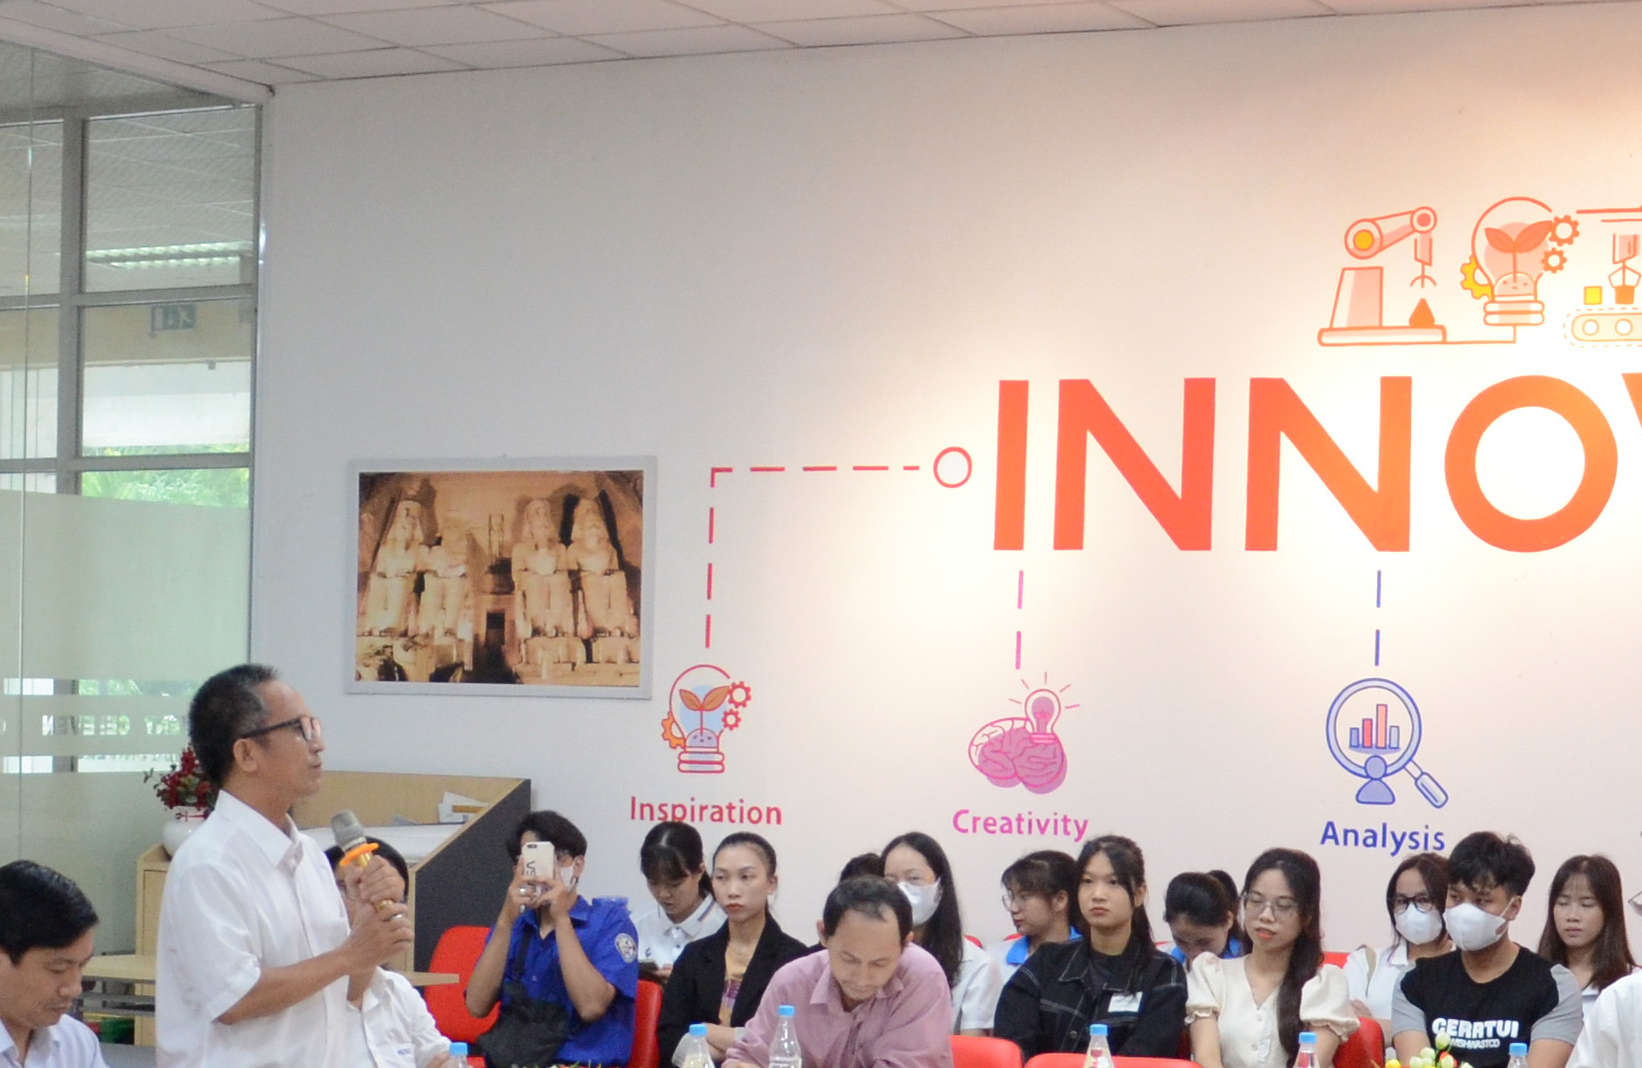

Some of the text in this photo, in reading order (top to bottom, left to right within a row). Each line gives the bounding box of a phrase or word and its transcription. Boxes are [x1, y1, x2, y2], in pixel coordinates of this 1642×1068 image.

[630, 796, 783, 823] Inspiration
[952, 808, 1089, 843] Creativity
[1320, 821, 1446, 857] Analysis
